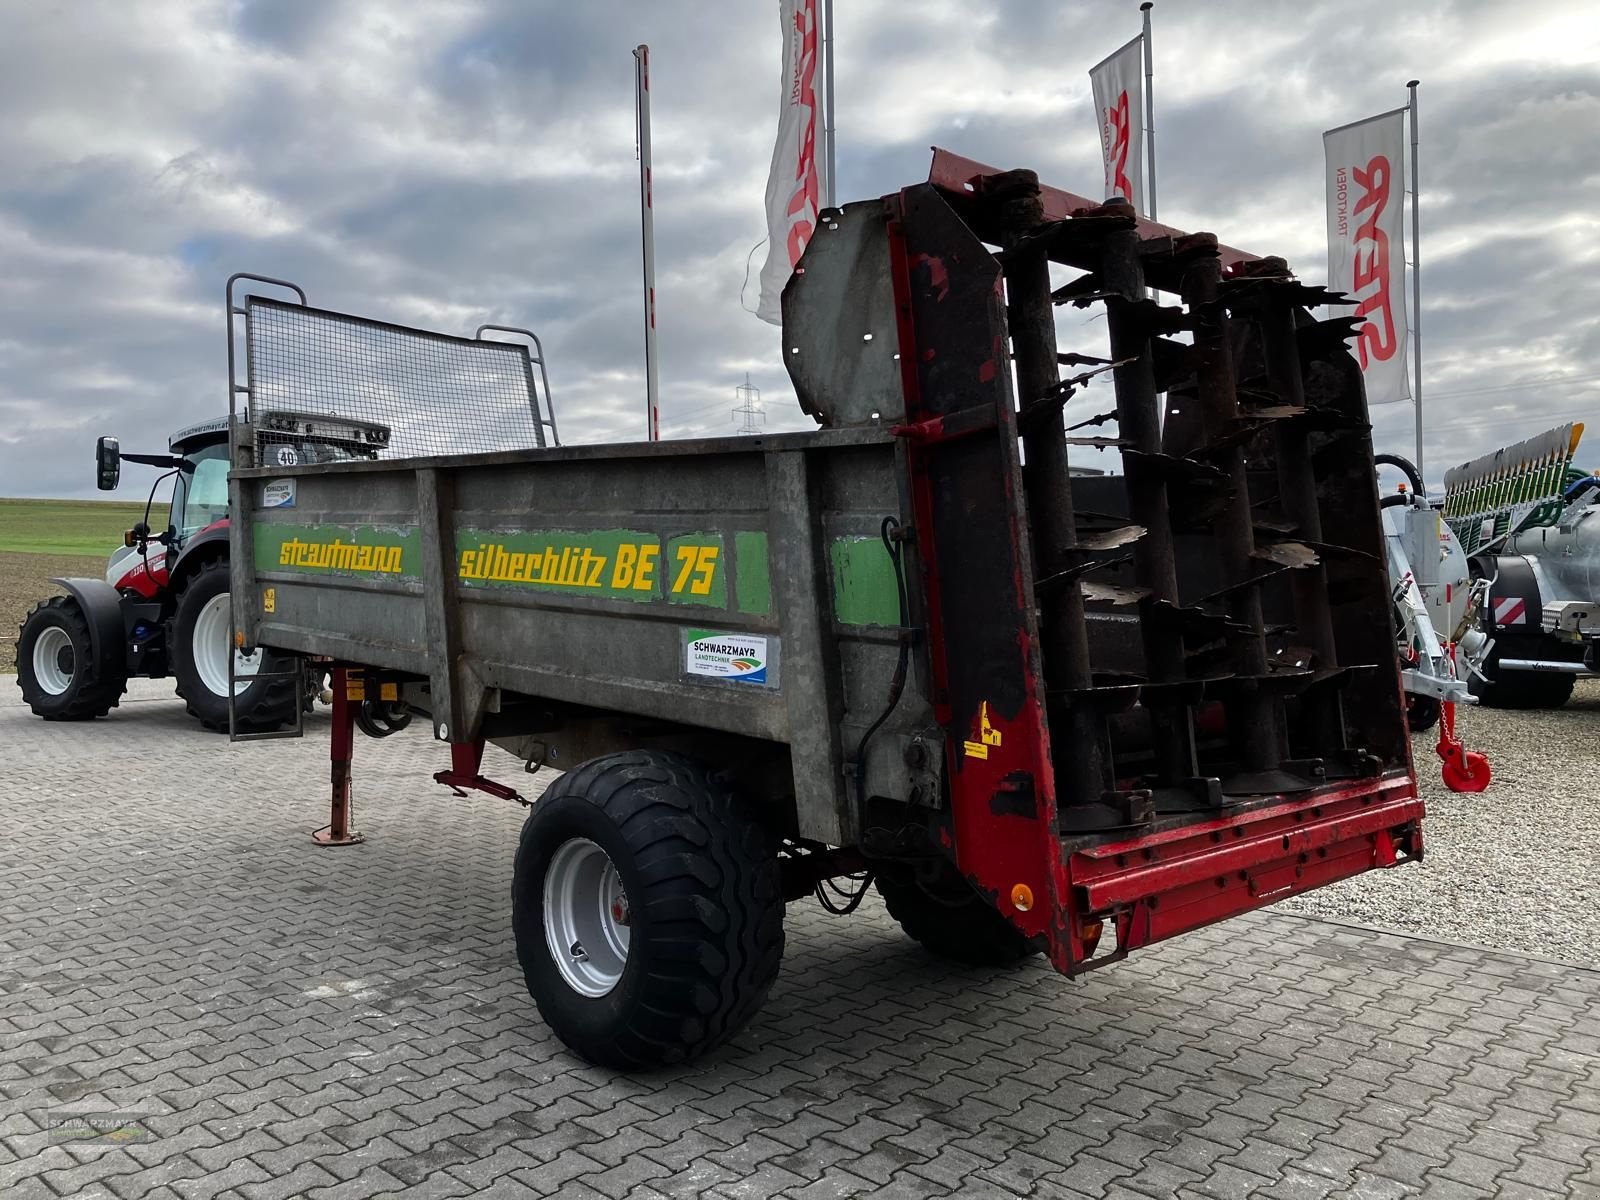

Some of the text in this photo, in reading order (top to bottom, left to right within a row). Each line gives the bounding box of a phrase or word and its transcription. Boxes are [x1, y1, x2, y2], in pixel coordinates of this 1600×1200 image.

[280, 451, 295, 465] 40
[279, 537, 402, 573] strautmann
[459, 543, 719, 595] silberblitz BE 75
[694, 641, 756, 657] SCHWARZMAYR
[695, 653, 730, 664] LANDTECHNIK
